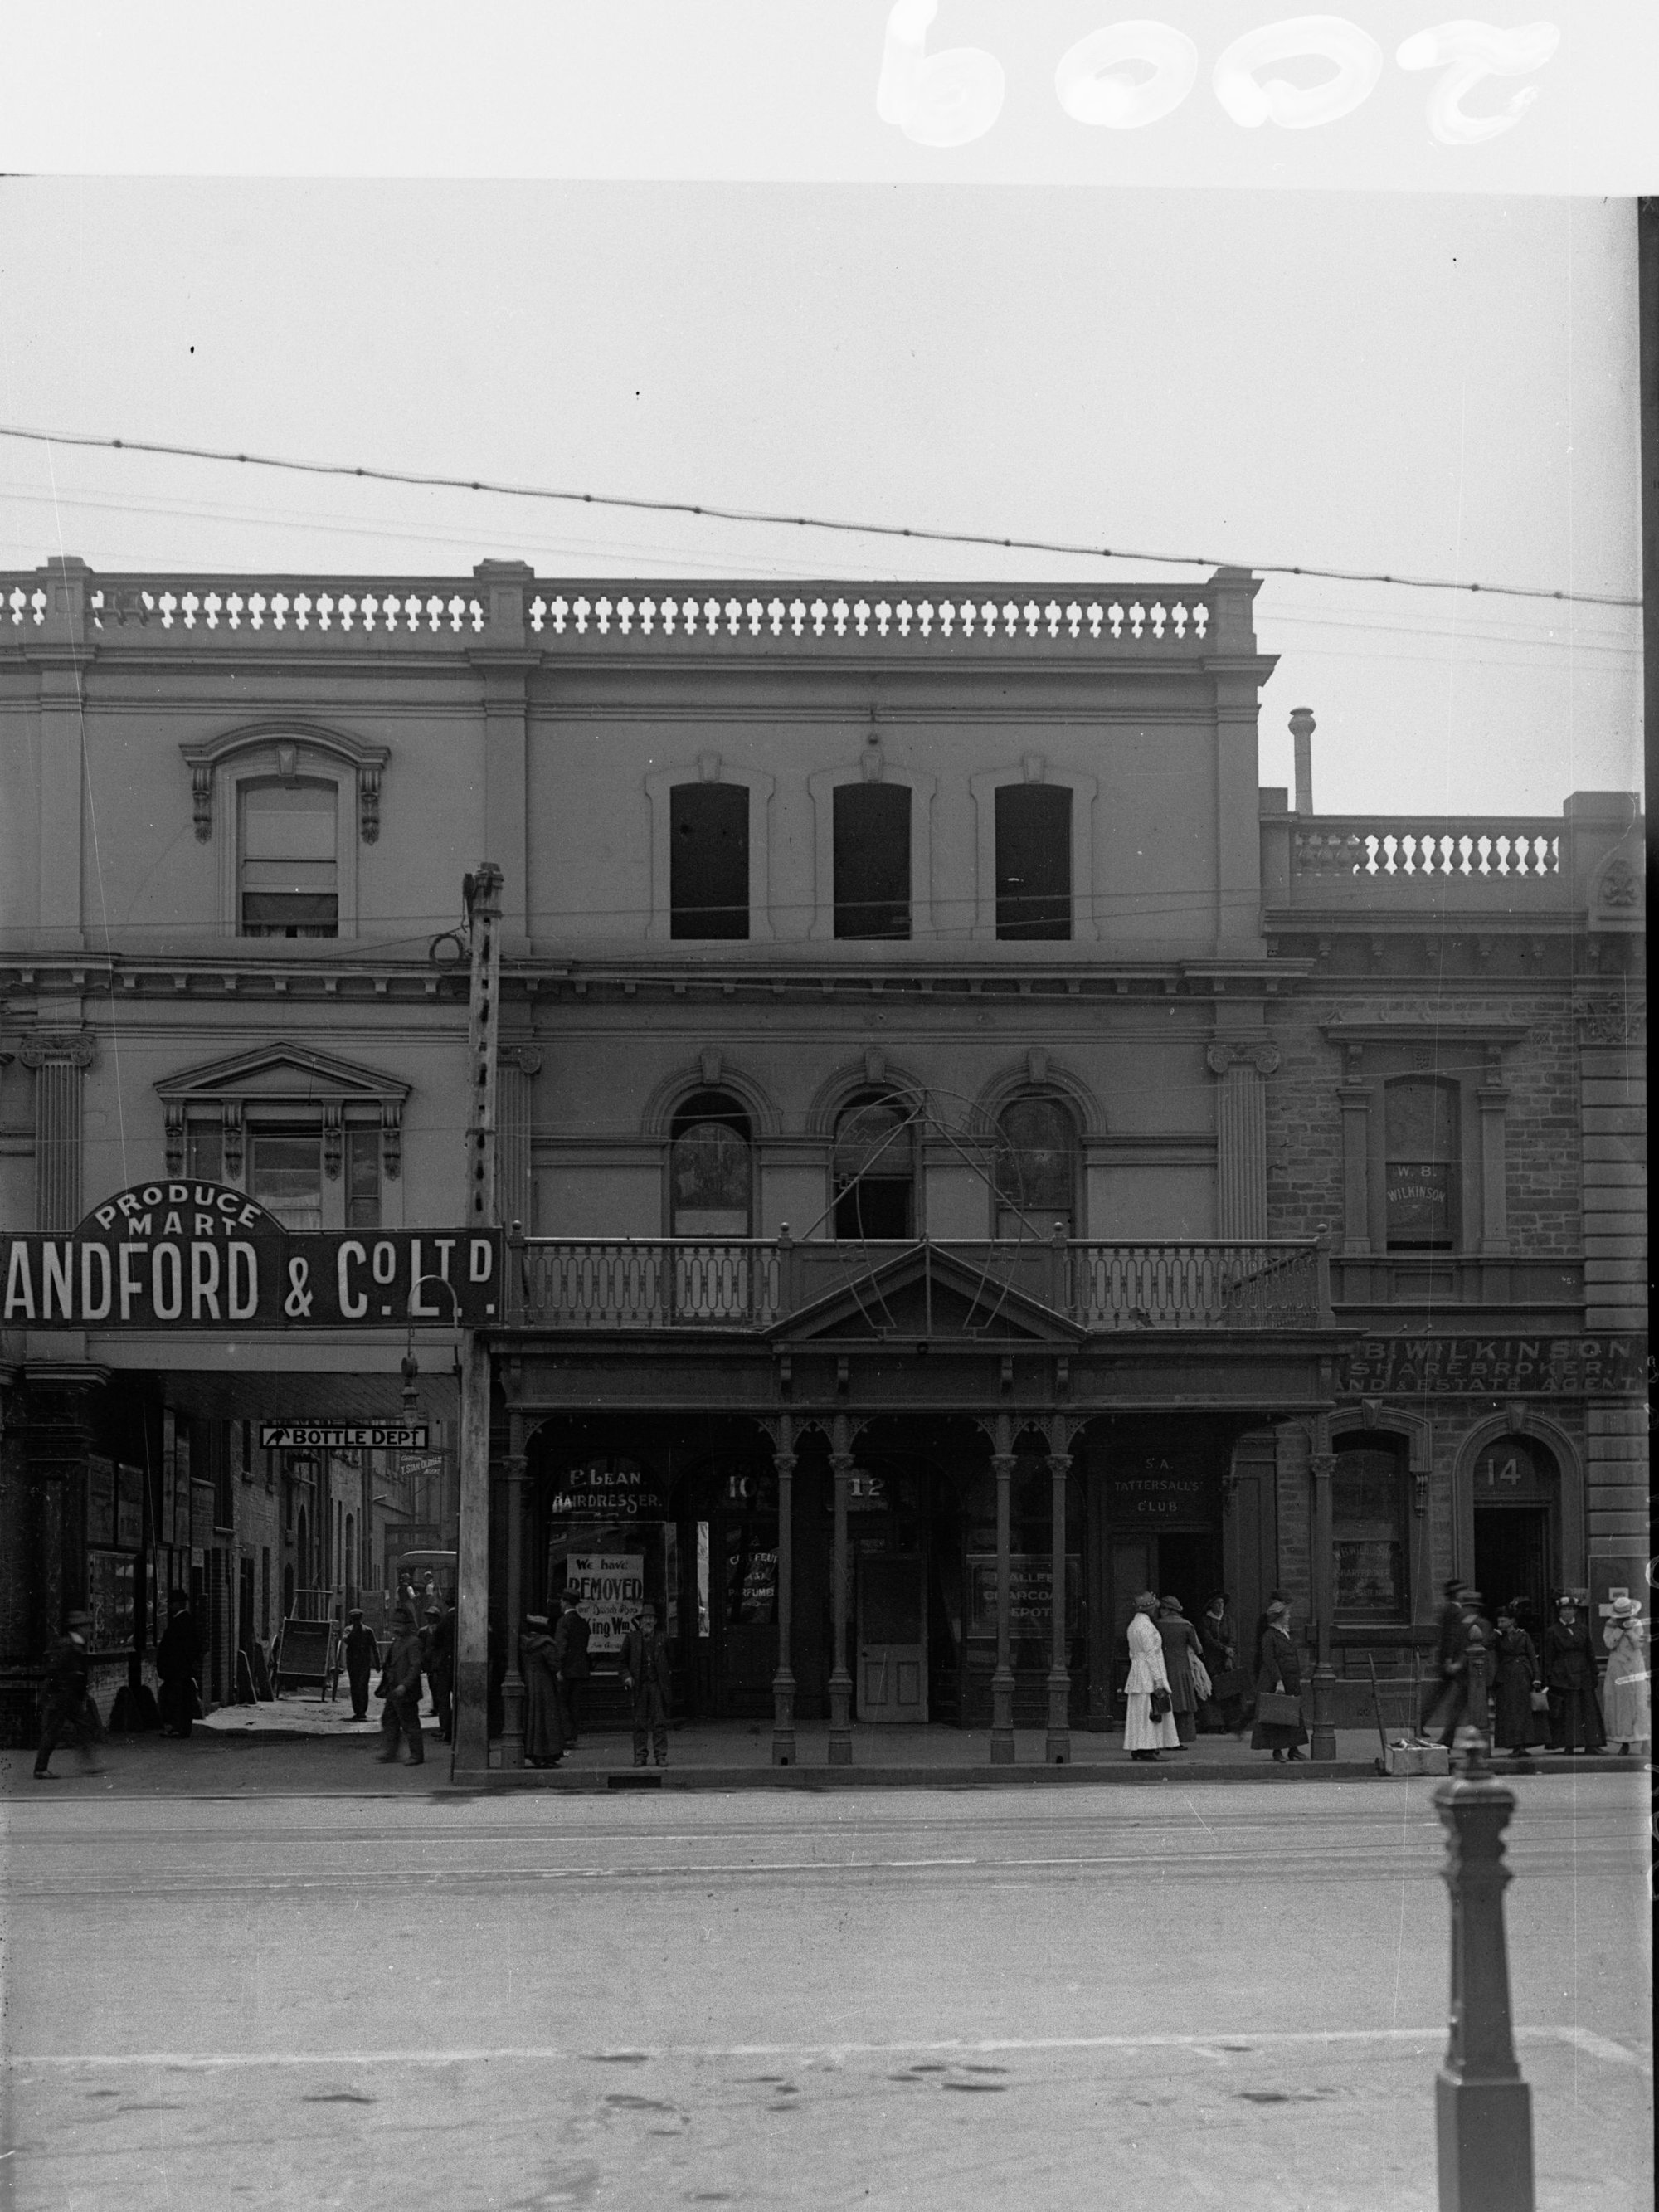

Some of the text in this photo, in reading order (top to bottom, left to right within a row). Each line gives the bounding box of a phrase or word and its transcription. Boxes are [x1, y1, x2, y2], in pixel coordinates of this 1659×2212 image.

[1387, 1186, 1446, 1202] WILKINSON
[95, 1185, 262, 1230] PRODUCE
[129, 1211, 237, 1235] MART
[284, 1255, 313, 1318] &
[1404, 1340, 1631, 1359] WILKINSON
[1417, 1378, 1520, 1392] ESTATE
[1540, 1377, 1636, 1392] AGENT
[293, 1429, 366, 1445] BOTTLE
[1487, 1459, 1521, 1486] 14
[730, 1475, 757, 1498] 10
[847, 1478, 885, 1497] 12
[1137, 1501, 1178, 1512] CLUB
